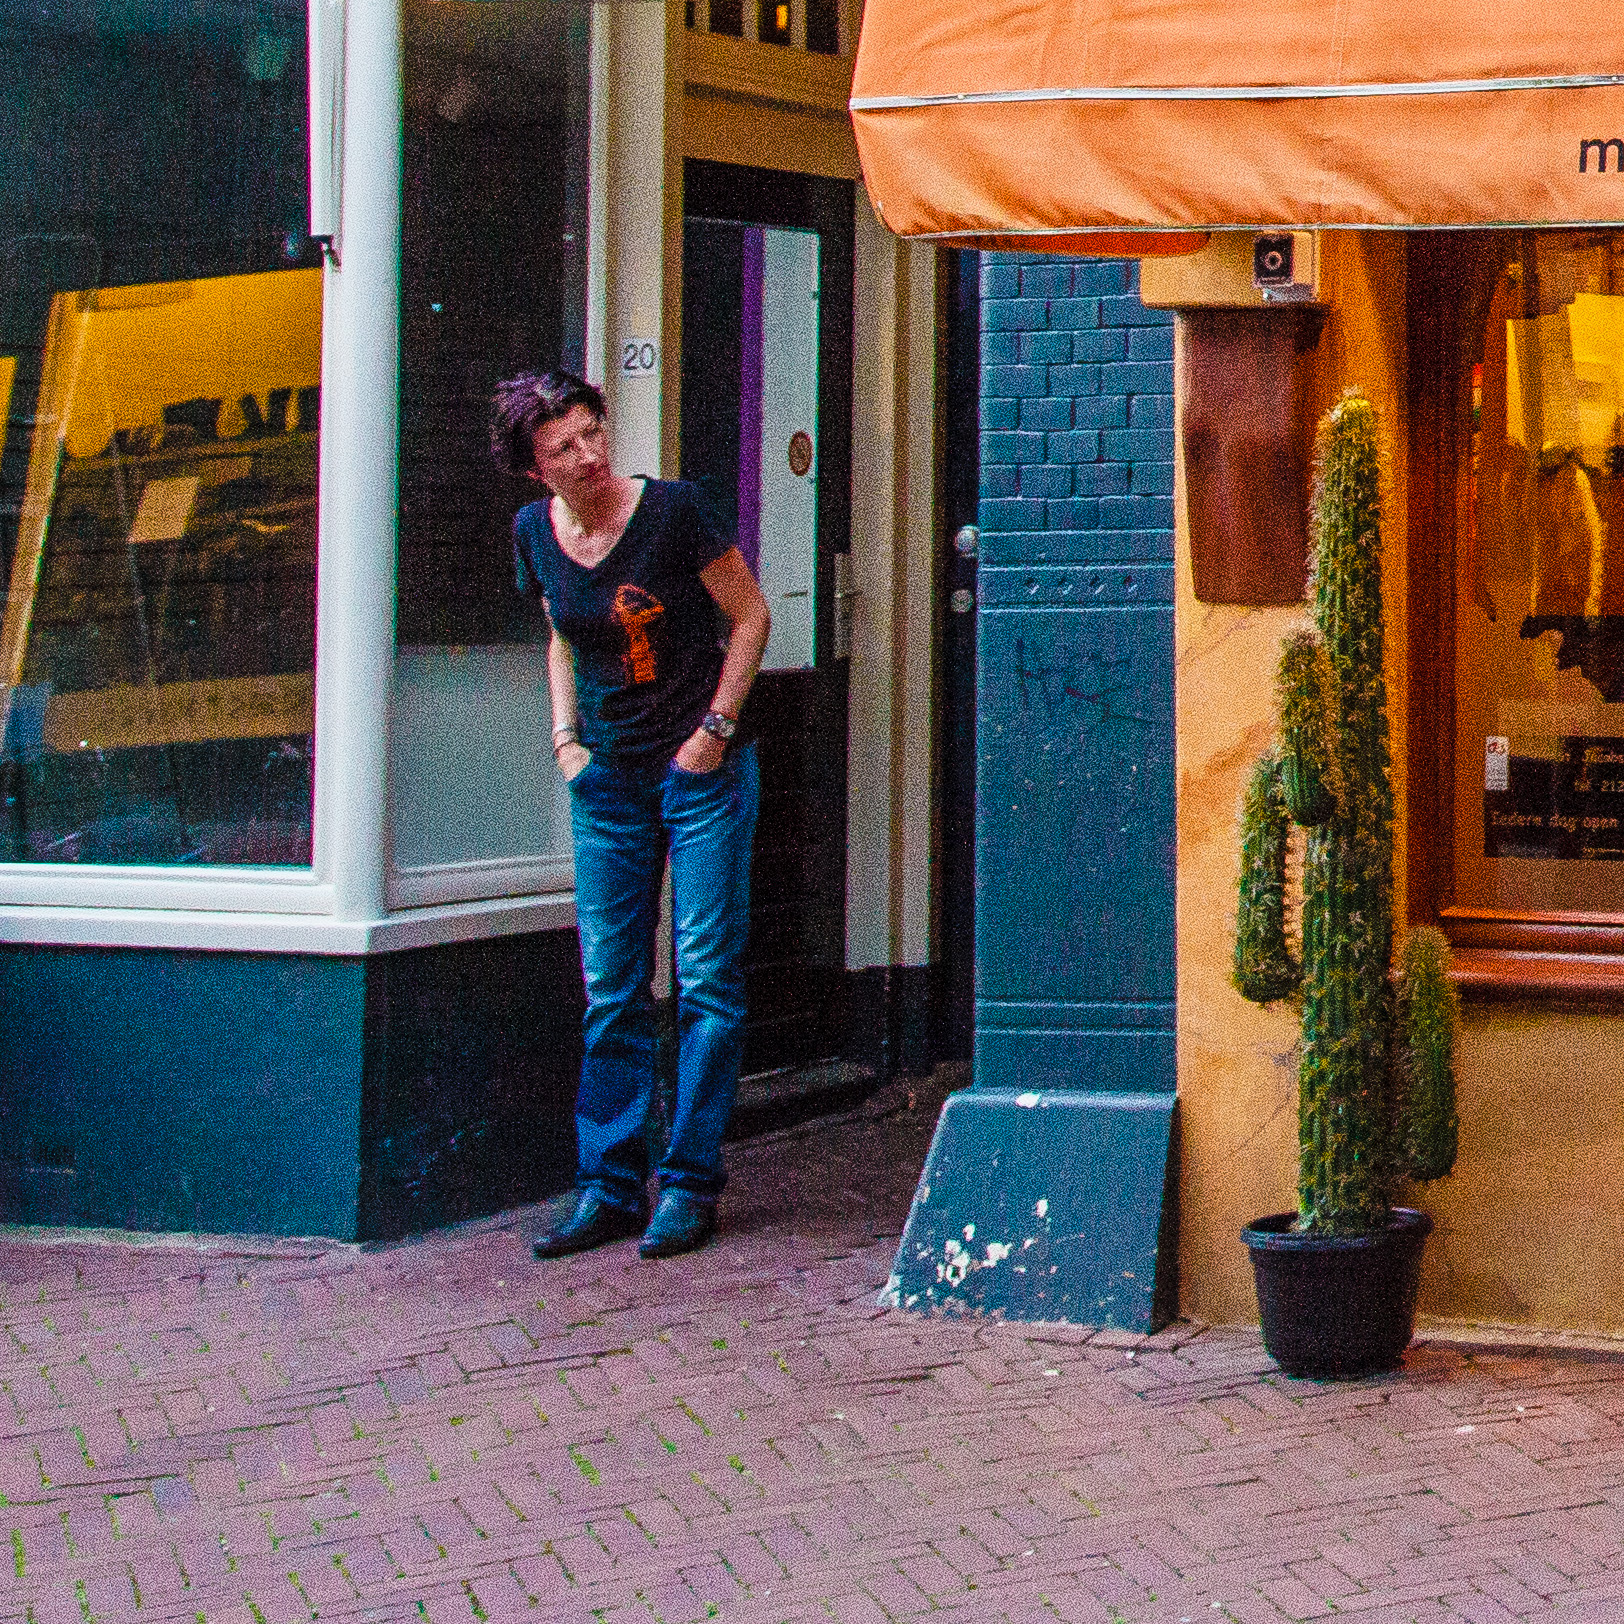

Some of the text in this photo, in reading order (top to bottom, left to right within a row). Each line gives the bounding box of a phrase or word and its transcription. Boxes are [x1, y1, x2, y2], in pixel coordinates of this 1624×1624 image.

[623, 342, 655, 371] 20
[1549, 813, 1577, 834] dag
[1582, 816, 1619, 833] open
